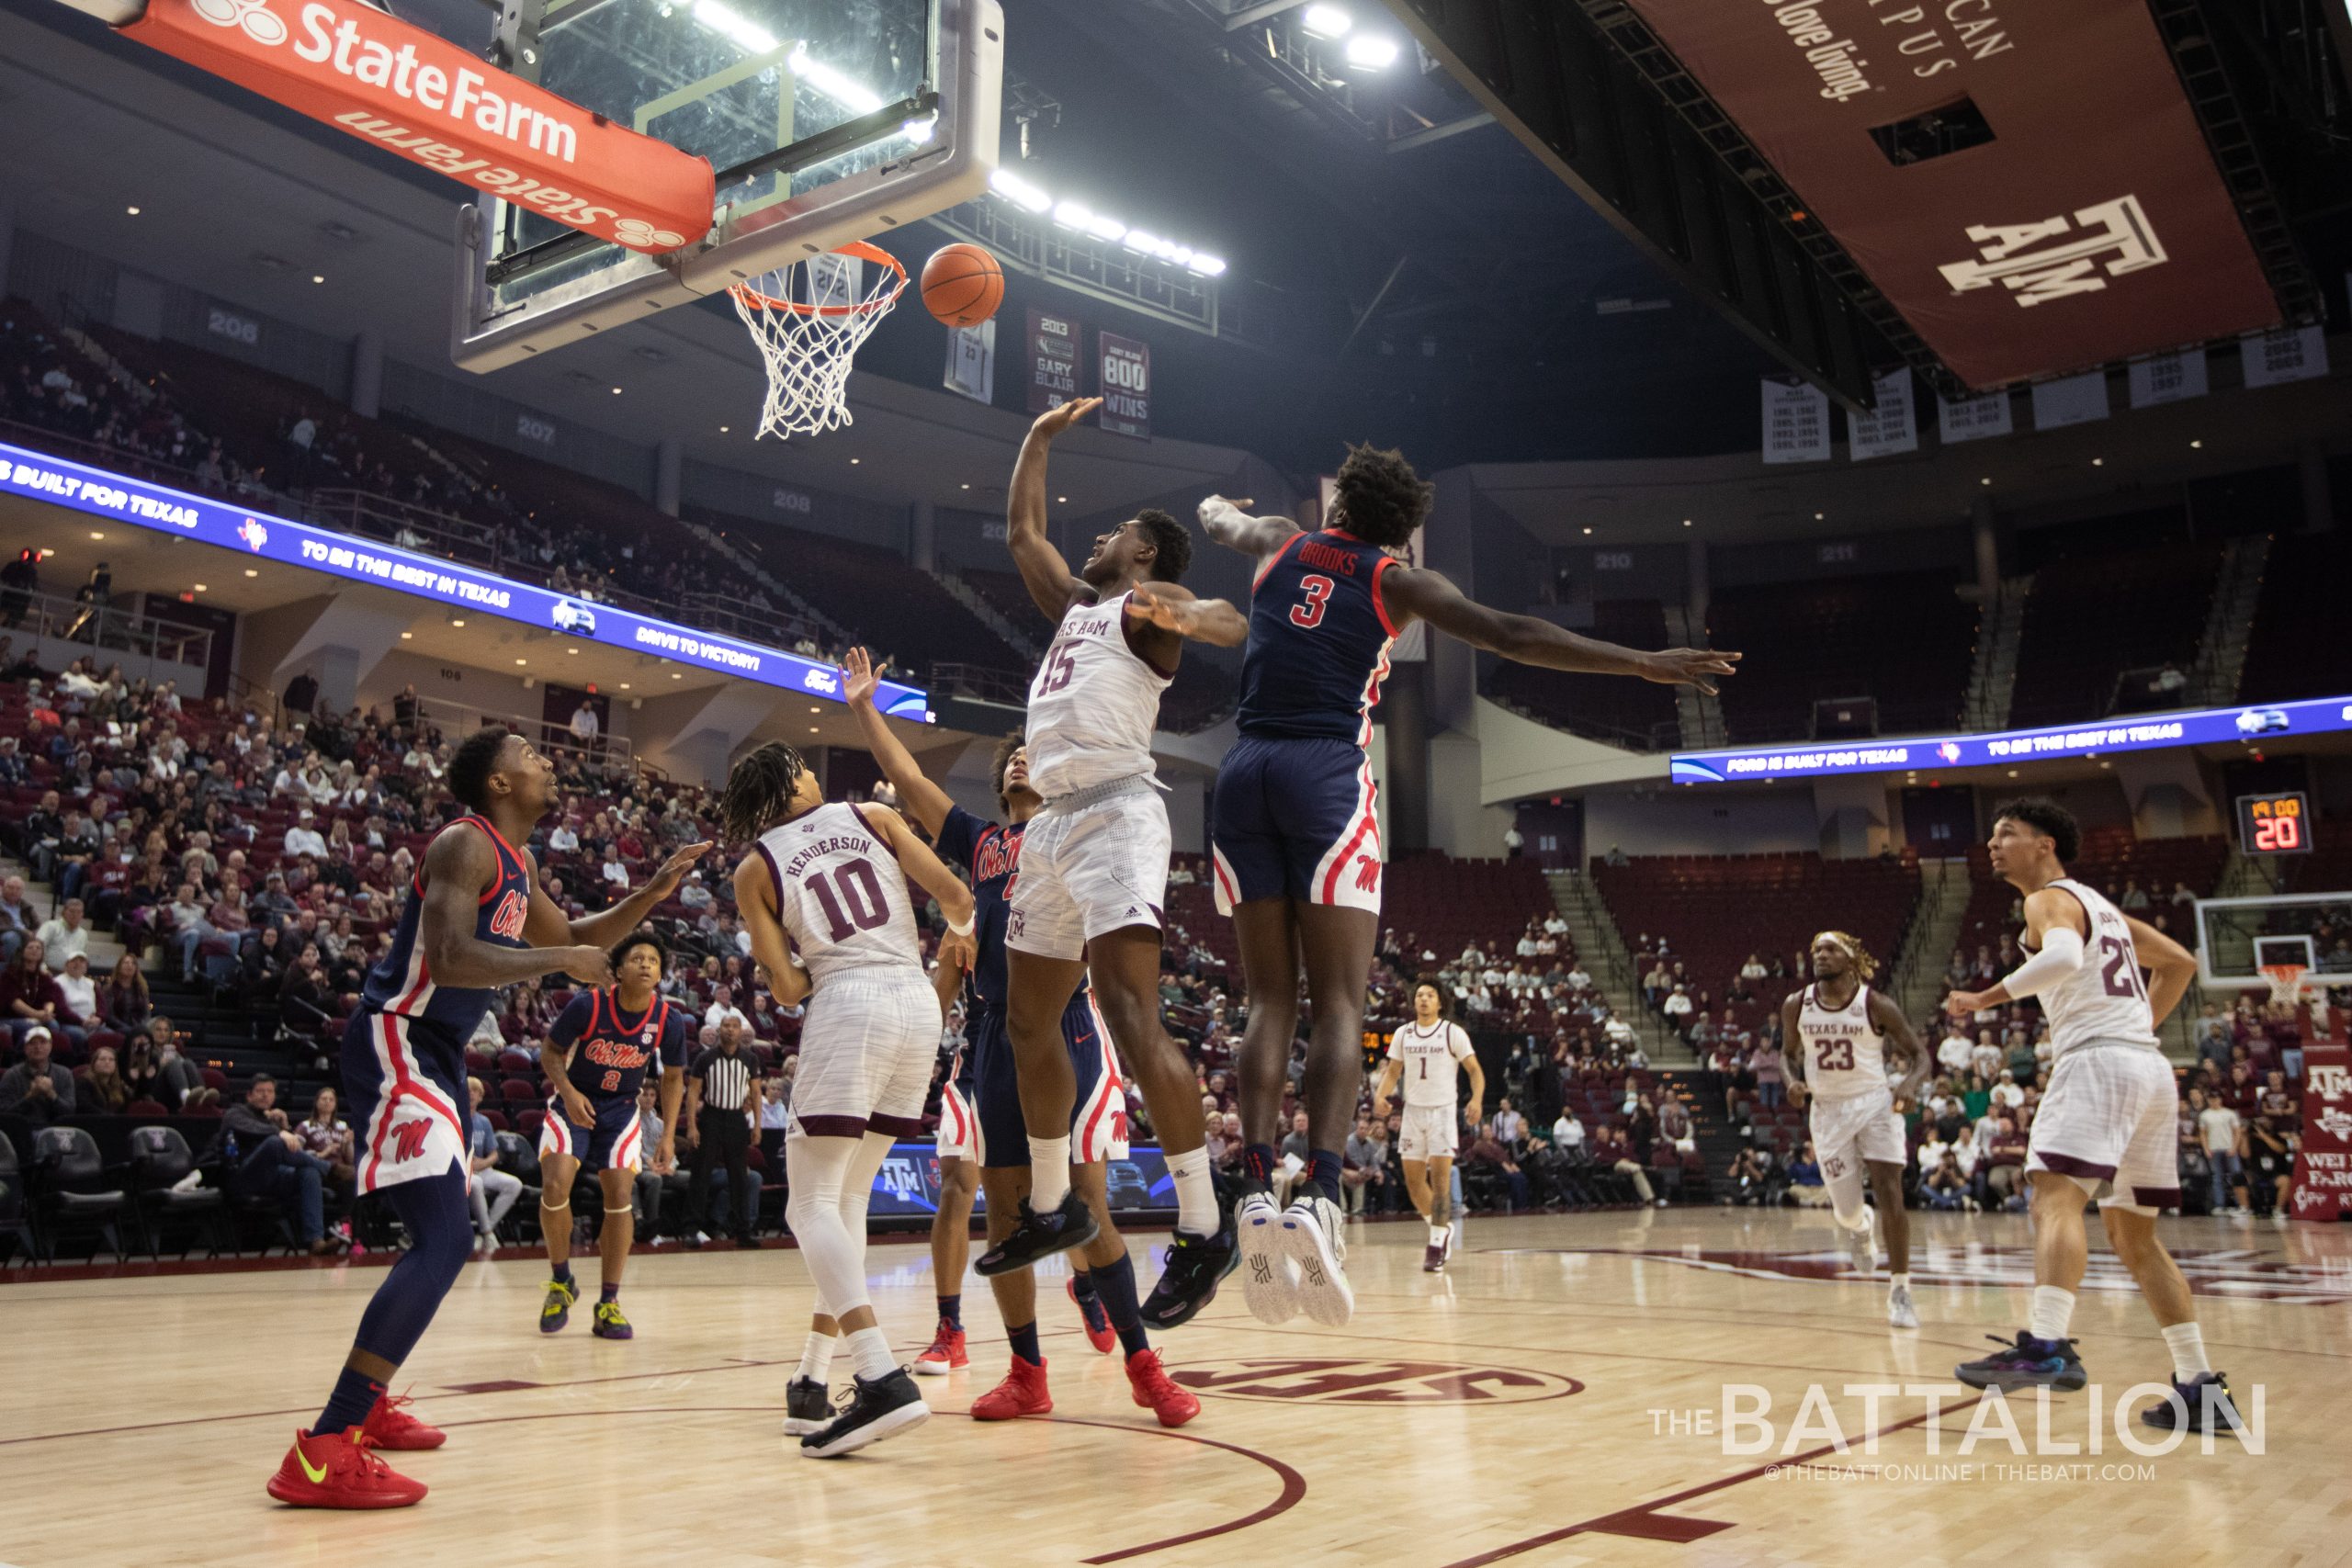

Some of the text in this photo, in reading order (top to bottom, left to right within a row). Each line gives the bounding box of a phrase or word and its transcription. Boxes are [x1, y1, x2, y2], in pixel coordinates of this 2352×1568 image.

[1041, 318, 1068, 336] 2013
[1037, 356, 1073, 377] GARY
[1104, 355, 1147, 391] 800
[1035, 373, 1075, 392] BLAIR
[1105, 392, 1148, 420] WINS
[518, 415, 553, 443] 207
[0, 460, 199, 528] S BUILT FOR TEXAS
[982, 522, 1007, 540] 20
[301, 539, 511, 609] TO BE THE BEST IN TEXAS
[1297, 541, 1359, 577] BROOKS
[1289, 574, 1335, 629] 3
[1077, 620, 1110, 637] A&M
[636, 626, 761, 671] DRIVE TO VICTORY!
[805, 669, 837, 694] Ford
[1036, 639, 1085, 698] 15
[1987, 723, 2183, 756] TO BE THE BEST IN TEXAS
[1726, 748, 1908, 773] FORD IS BUILT FOR TEXAS
[2255, 817, 2300, 851] 20
[786, 836, 871, 878] HENDERSON
[978, 840, 1005, 882] Ole
[804, 858, 890, 943] 10
[1803, 1024, 1864, 1036] TEXAS A&M
[585, 1038, 614, 1065] Ole
[1815, 1038, 1855, 1070] 23
[600, 1069, 621, 1091] 2
[1419, 1057, 1427, 1079] 1
